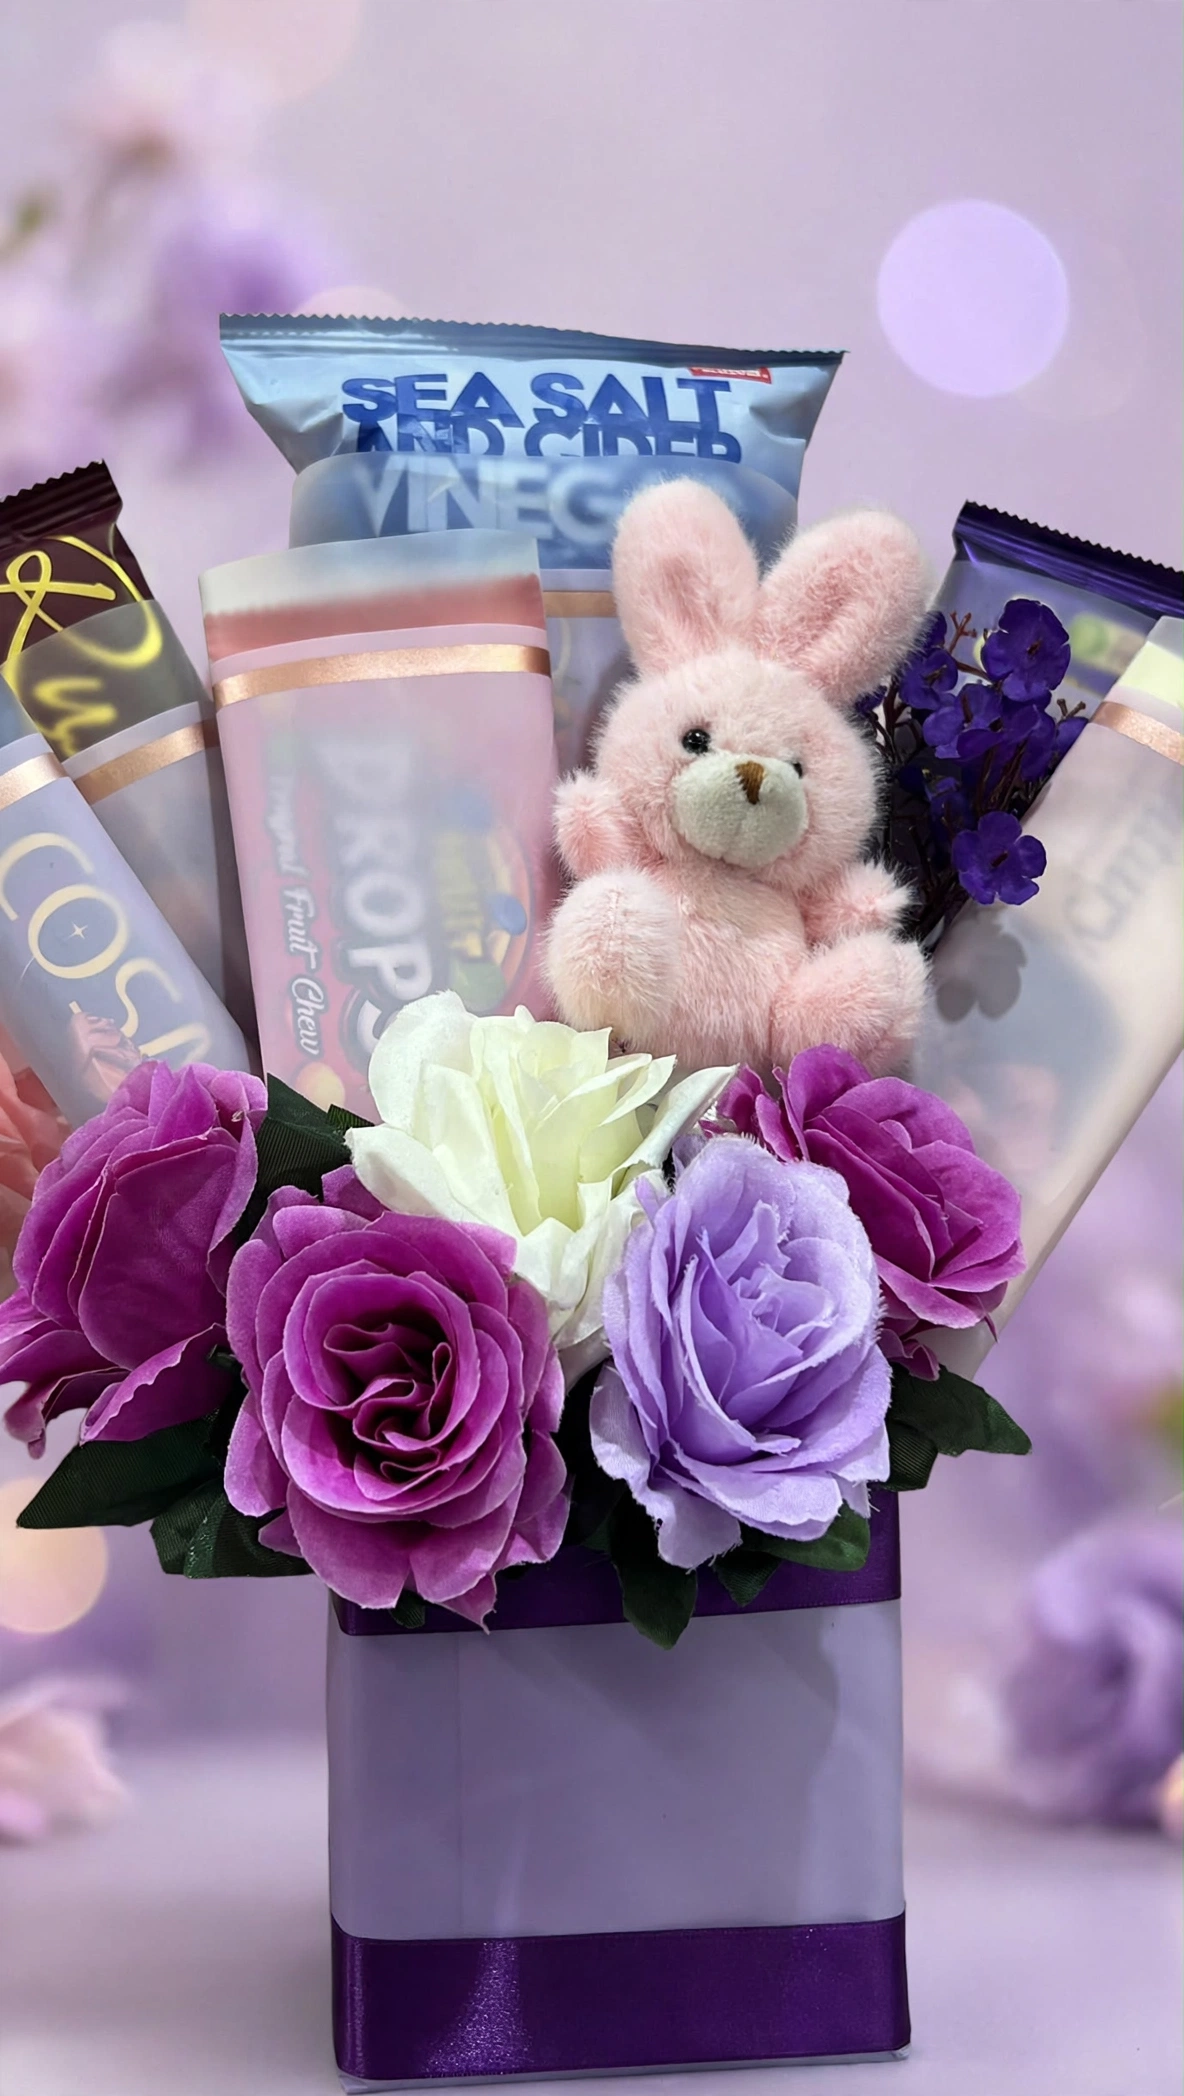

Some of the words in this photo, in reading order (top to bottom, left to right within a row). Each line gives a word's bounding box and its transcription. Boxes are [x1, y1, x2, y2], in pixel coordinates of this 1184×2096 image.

[342, 372, 525, 428] SEA
[530, 372, 732, 432] SALT
[357, 414, 505, 458] AND
[353, 454, 738, 542] VINEG
[283, 886, 319, 970] Fruit
[291, 976, 325, 1056] Chew
